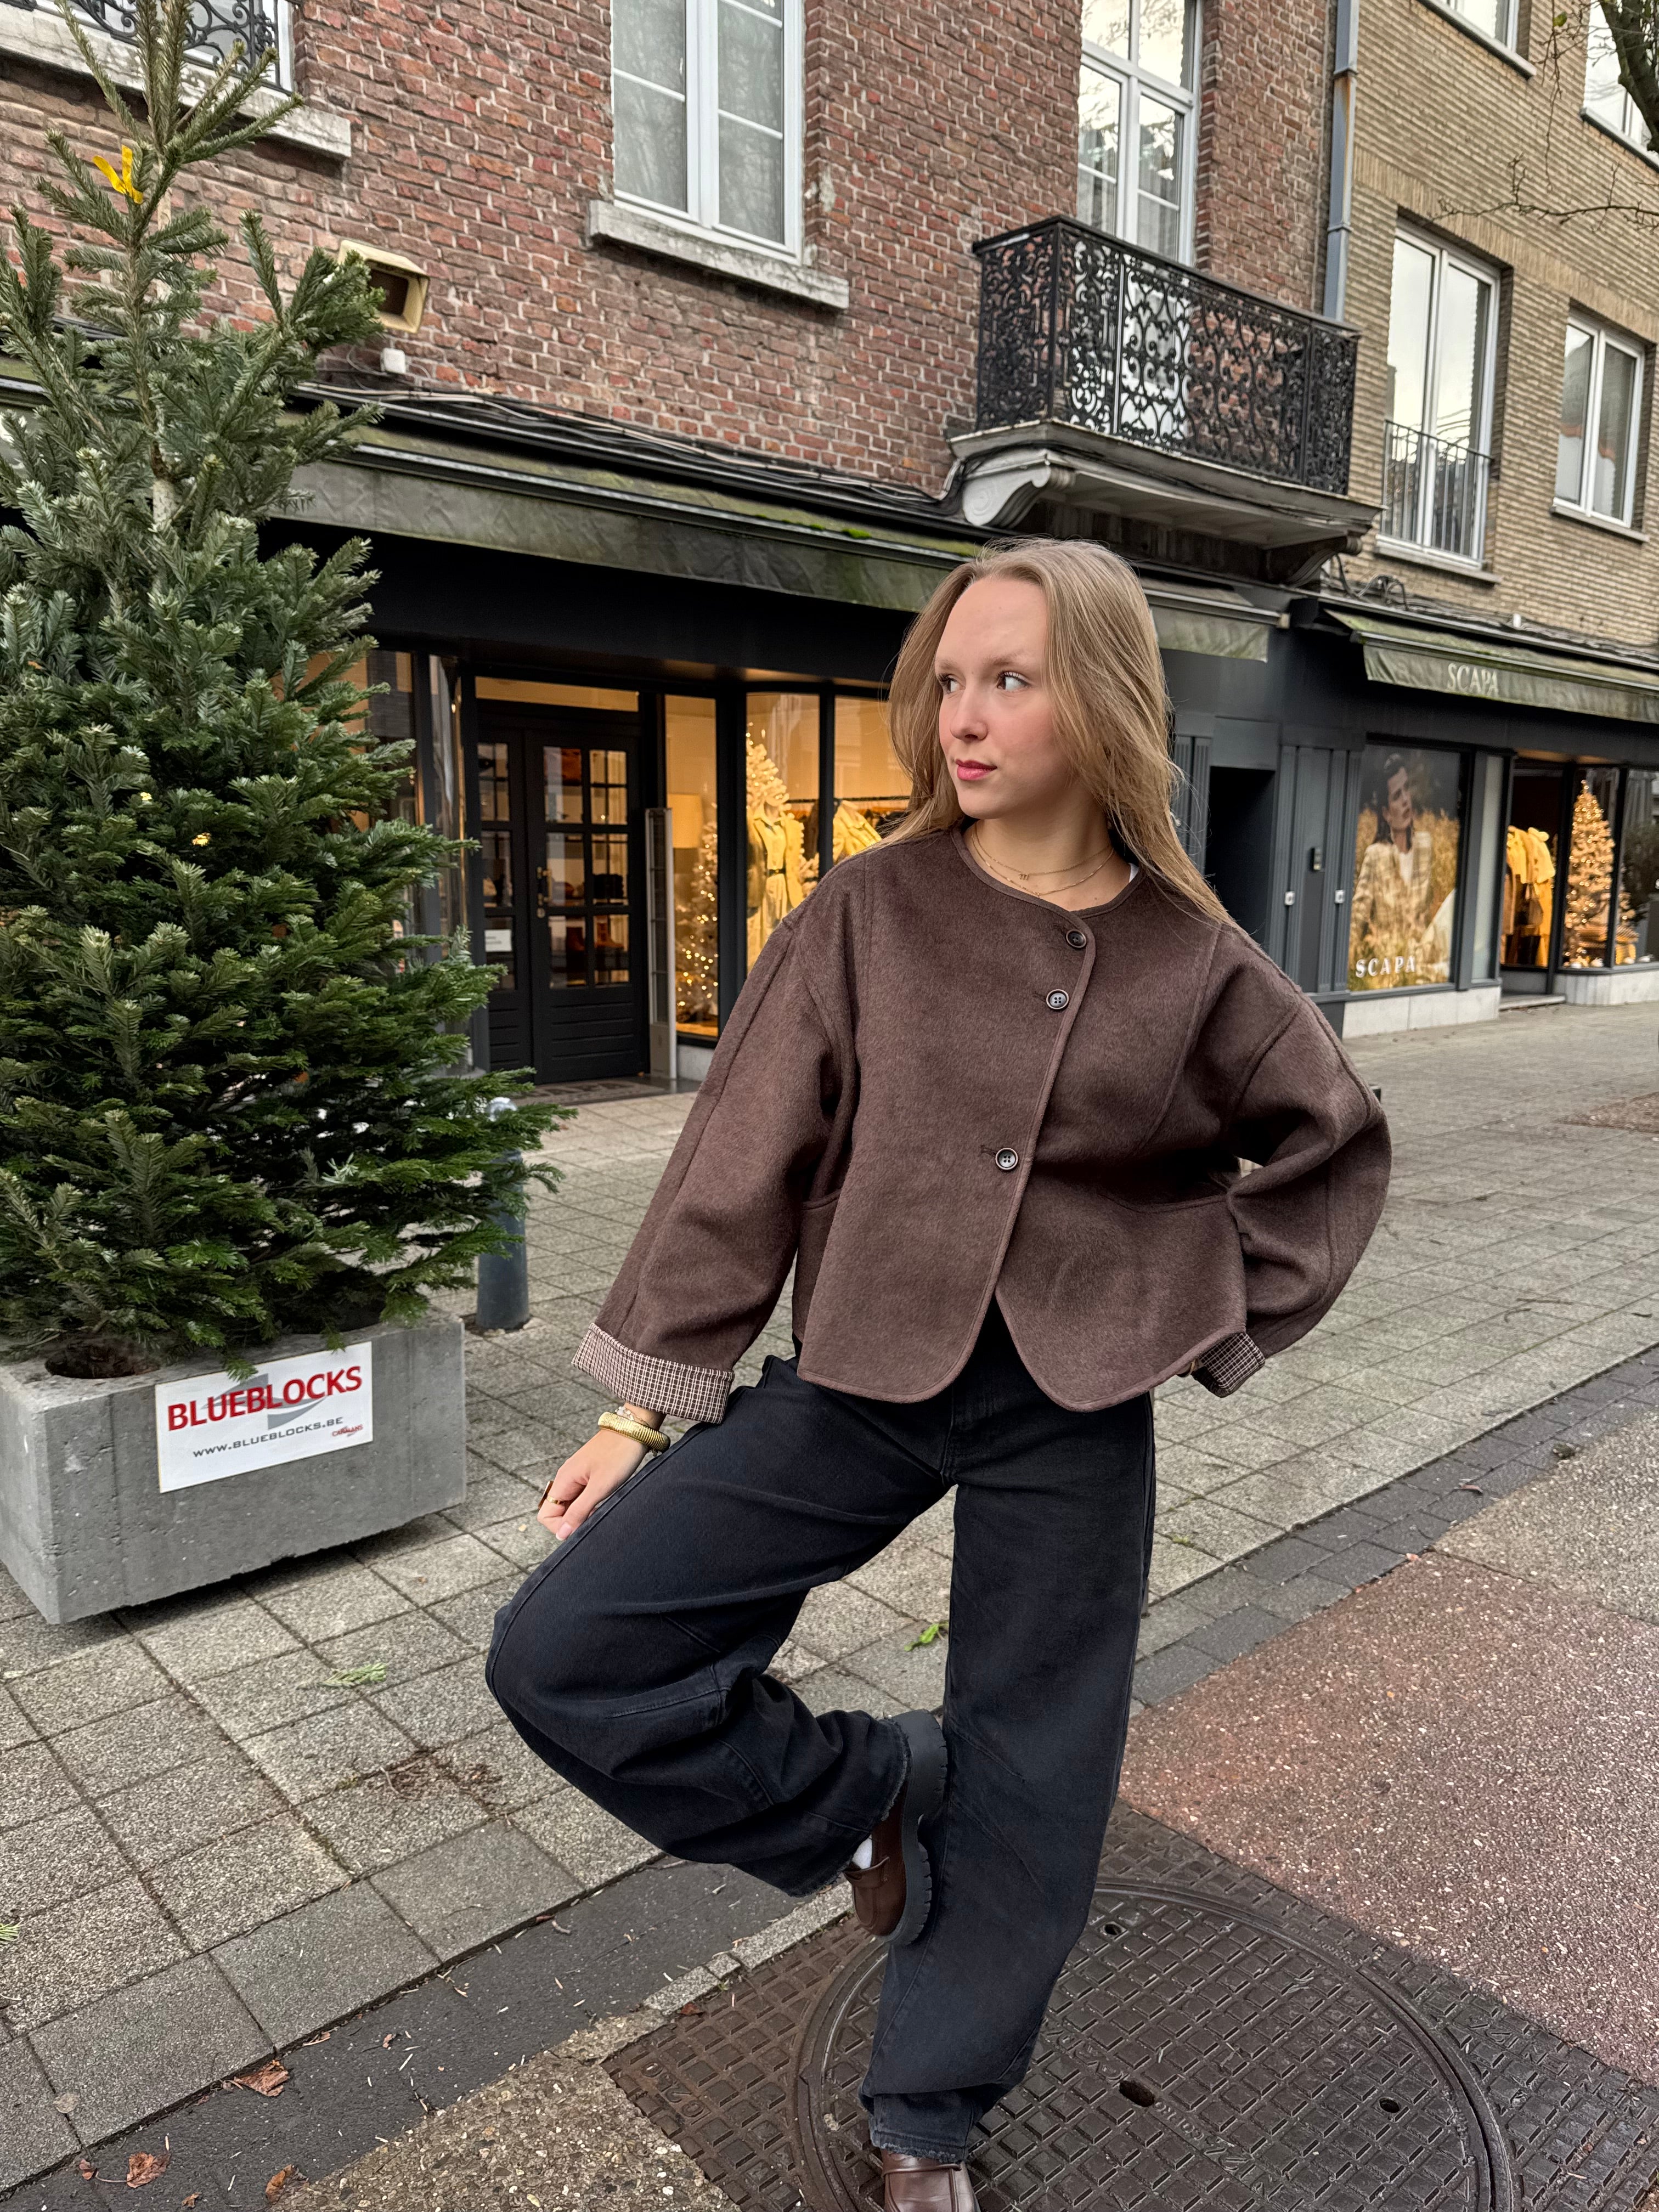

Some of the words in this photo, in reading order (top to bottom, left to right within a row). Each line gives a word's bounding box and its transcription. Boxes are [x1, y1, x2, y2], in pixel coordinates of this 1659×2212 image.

[1447, 663, 1499, 698] SCAPA
[1355, 956, 1415, 978] SCAPA
[167, 1365, 363, 1431] BLUEBLOCKS
[193, 1417, 344, 1457] WWW.BLUEBLOCKS.BE
